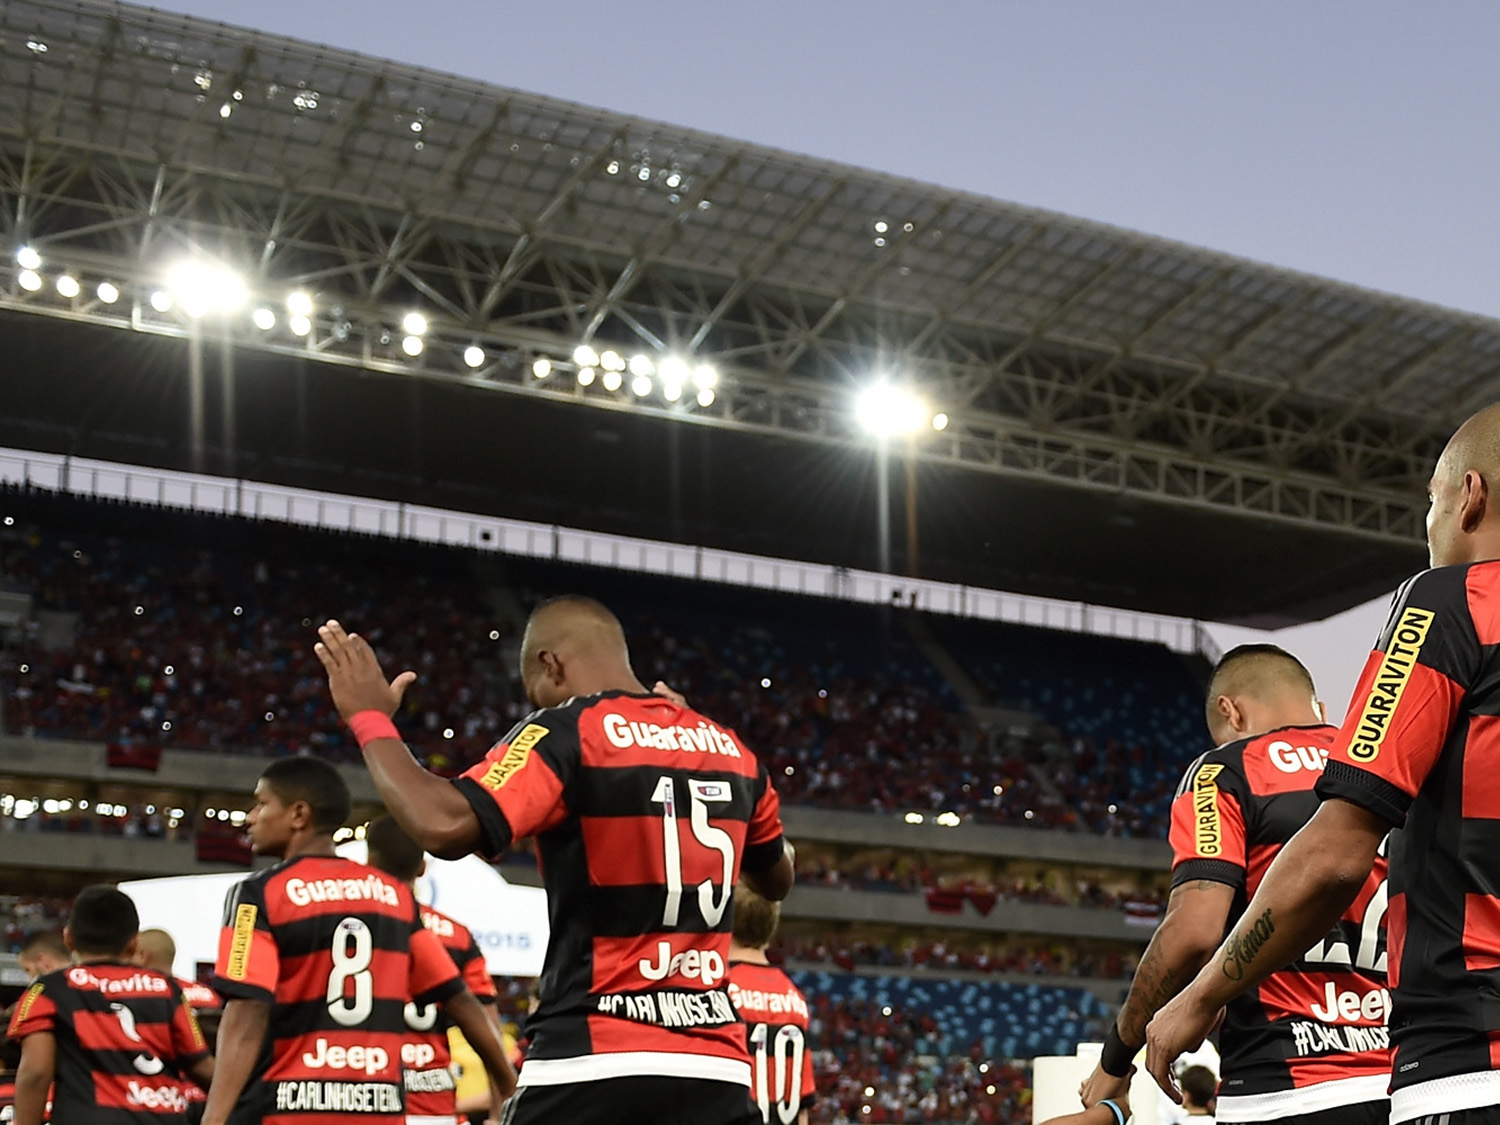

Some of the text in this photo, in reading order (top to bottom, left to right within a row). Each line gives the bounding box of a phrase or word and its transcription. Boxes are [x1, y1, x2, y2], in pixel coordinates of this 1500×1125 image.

[1353, 611, 1430, 759] GUARAVITON
[603, 713, 741, 758] Guaravita
[1197, 765, 1222, 855] GUARAVITON
[285, 874, 399, 907] Guaravita
[651, 776, 734, 927] 15
[327, 917, 373, 1027] 8
[639, 942, 725, 985] Jeep
[1222, 907, 1276, 981] Amor
[302, 1038, 389, 1075] Jeep
[749, 1023, 805, 1125] 10
